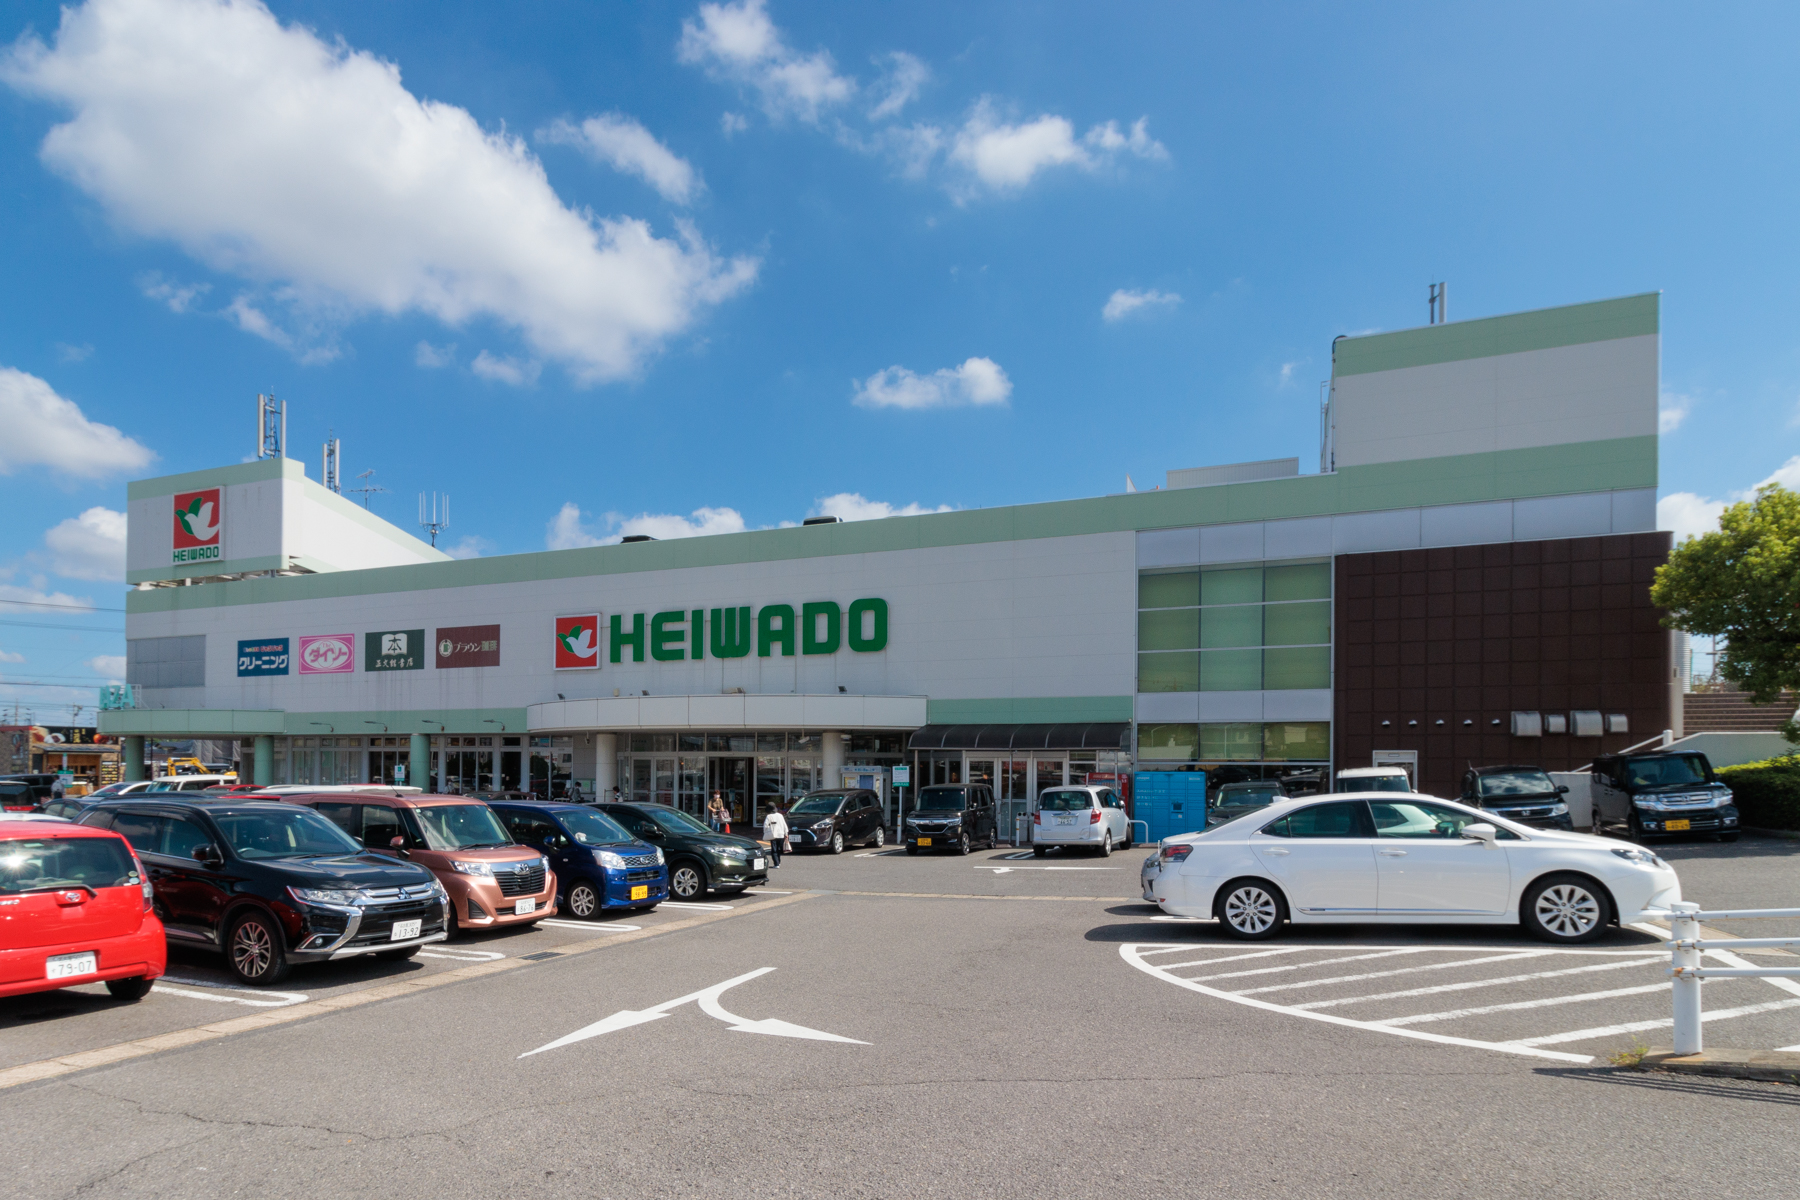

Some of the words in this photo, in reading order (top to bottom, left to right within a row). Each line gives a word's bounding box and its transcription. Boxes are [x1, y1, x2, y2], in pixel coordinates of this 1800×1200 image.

[173, 546, 219, 562] HEIWADO
[610, 597, 888, 663] HEIWADO
[387, 636, 402, 654] 本
[239, 654, 288, 670] クリーニング
[309, 647, 348, 663] ダイソー
[399, 926, 419, 938] 13-92
[58, 960, 92, 976] 79-07
